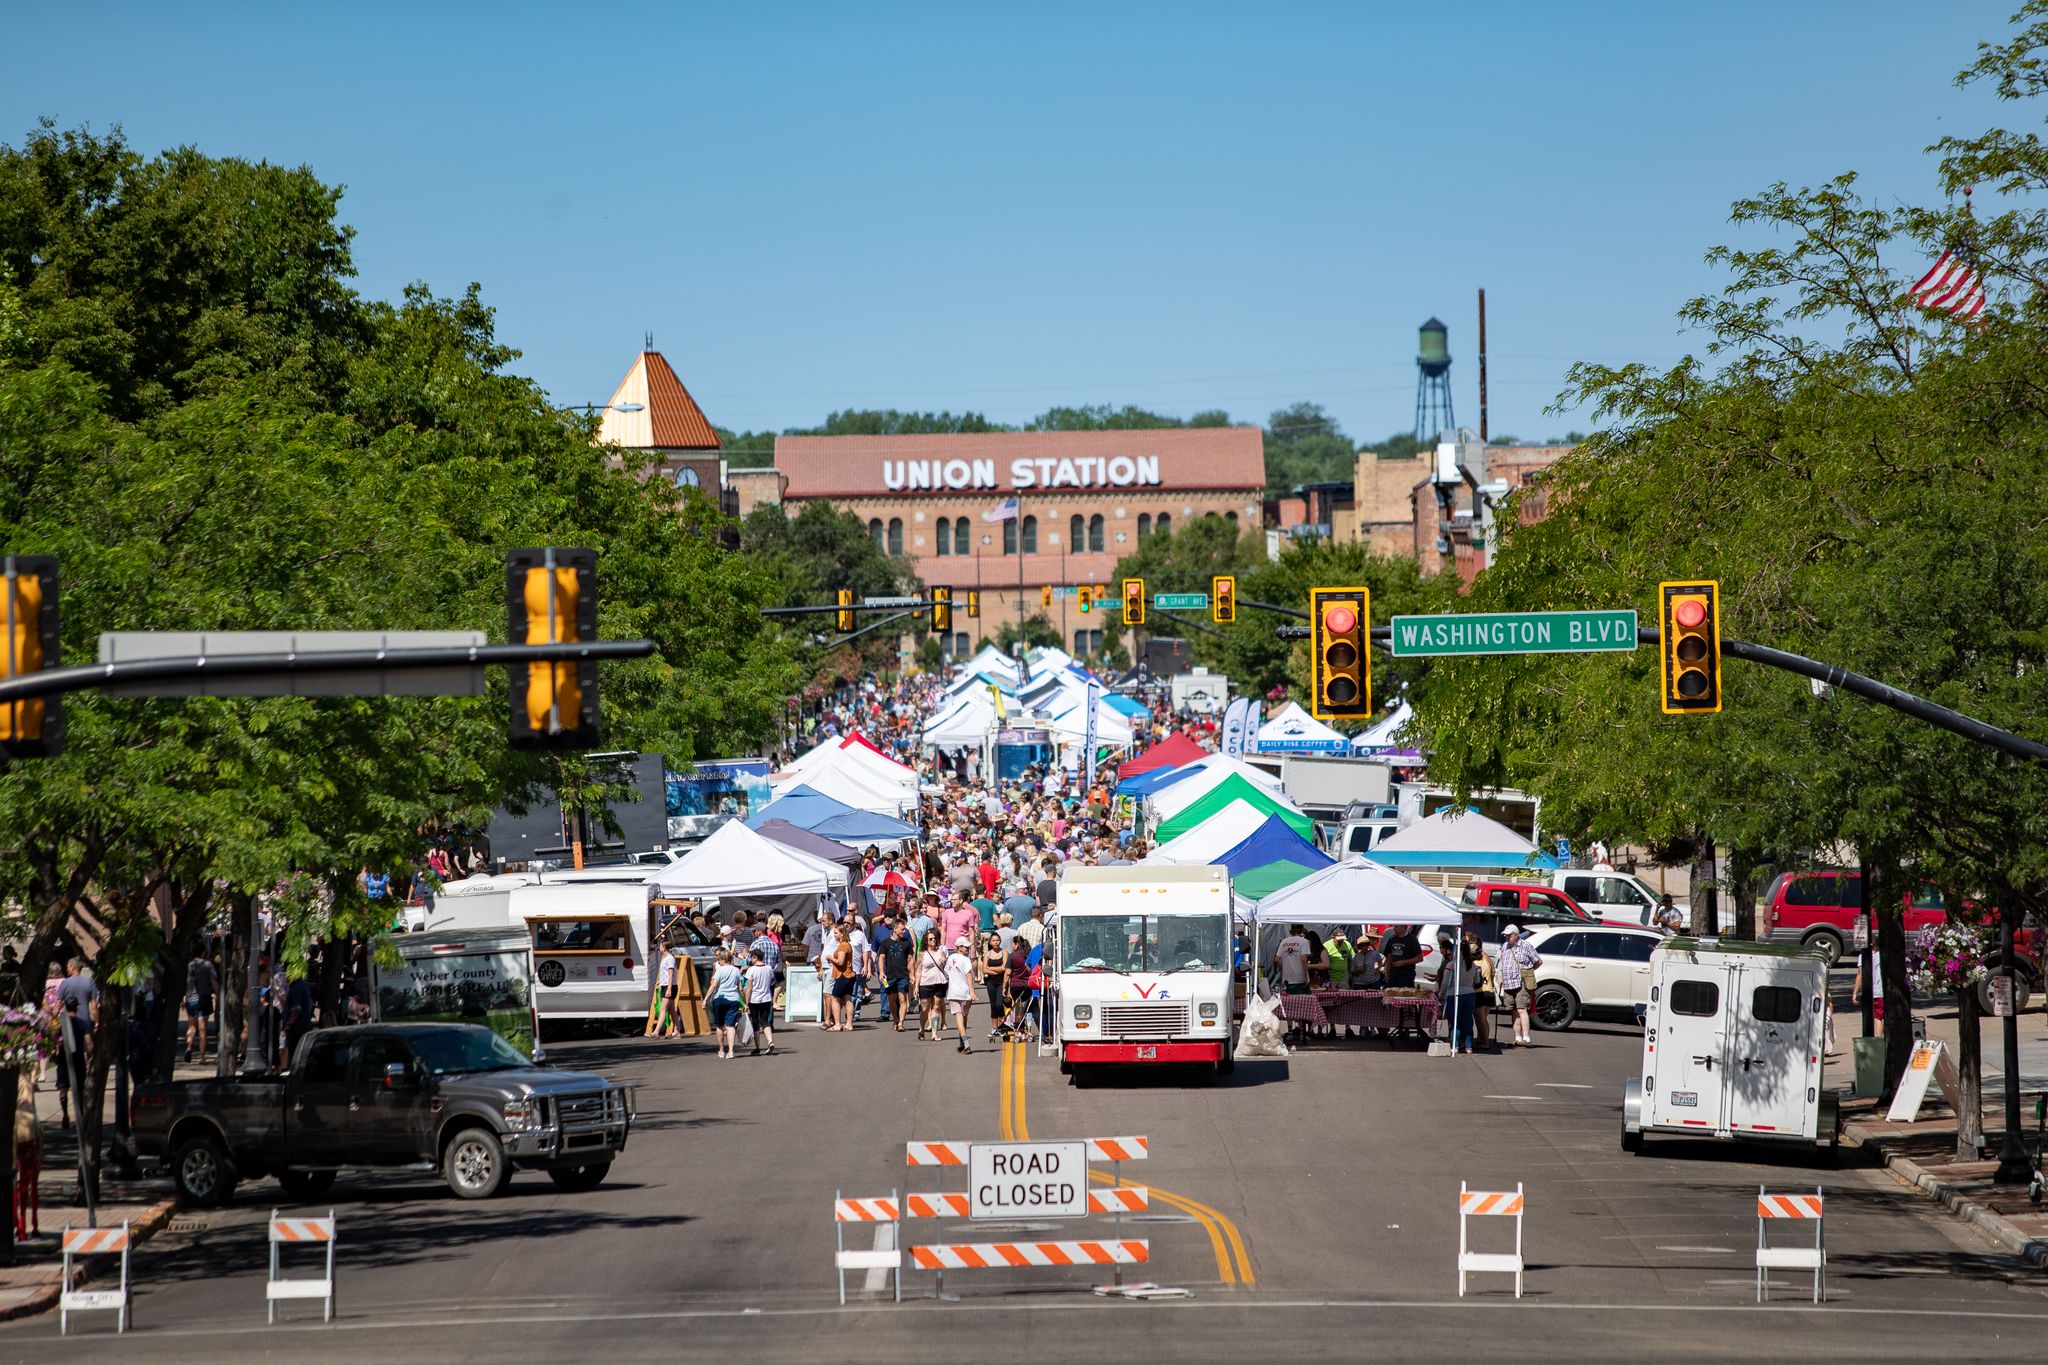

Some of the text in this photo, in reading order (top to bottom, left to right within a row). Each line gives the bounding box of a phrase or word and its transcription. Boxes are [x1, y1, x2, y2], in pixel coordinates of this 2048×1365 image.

[883, 455, 1160, 489] UNION STATION
[1170, 597, 1188, 606] GRANT
[1401, 621, 1551, 647] WASHINGTON
[410, 970, 449, 983] Weber
[452, 967, 498, 981] County
[403, 980, 509, 998] FARM BUREAU
[993, 1152, 1060, 1176] ROAD
[979, 1183, 1075, 1207] CLOSED
